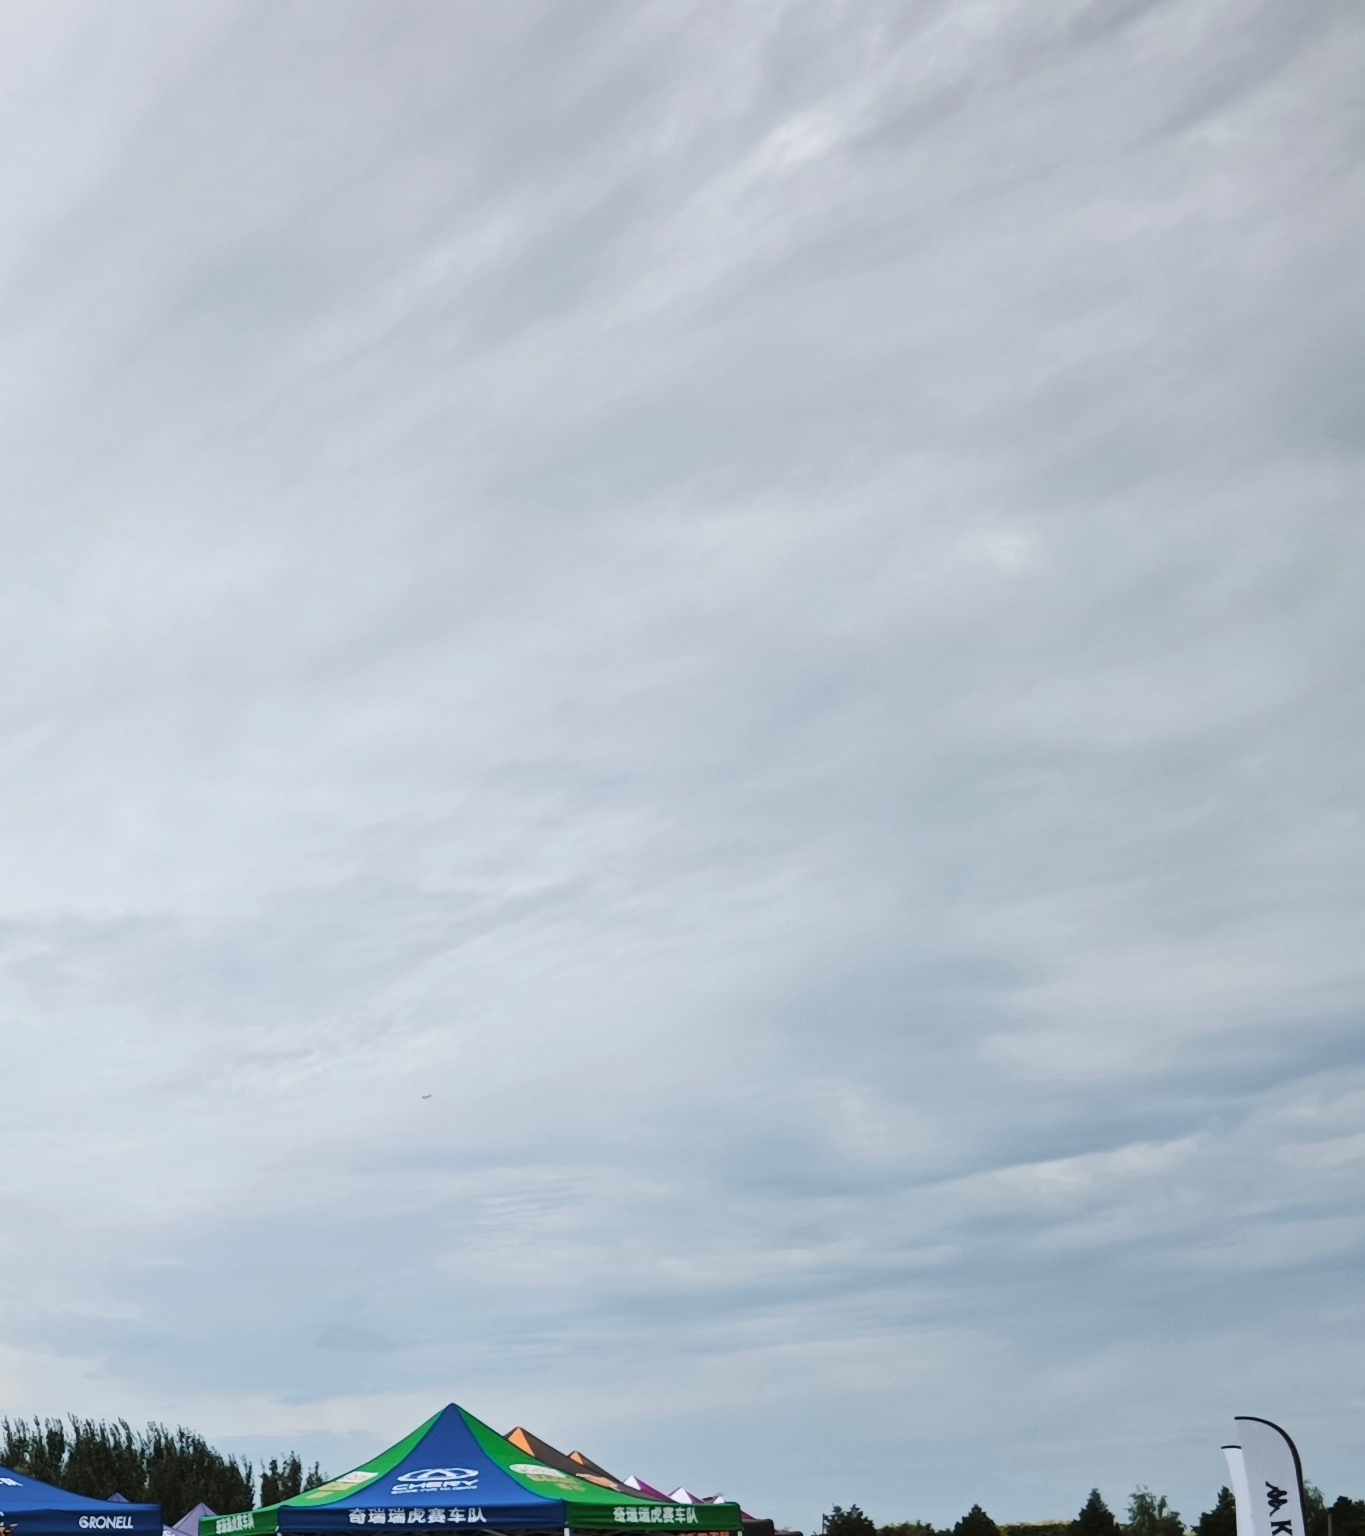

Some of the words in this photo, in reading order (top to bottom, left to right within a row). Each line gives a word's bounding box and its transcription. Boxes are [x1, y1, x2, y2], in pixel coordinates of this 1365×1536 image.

[391, 1479, 480, 1491] CHERY
[78, 1515, 134, 1530] GRONELL
[348, 1507, 487, 1525] 奇瑞瑞虎赛车队
[613, 1506, 699, 1524] 奇瑞瑞虎赛车队
